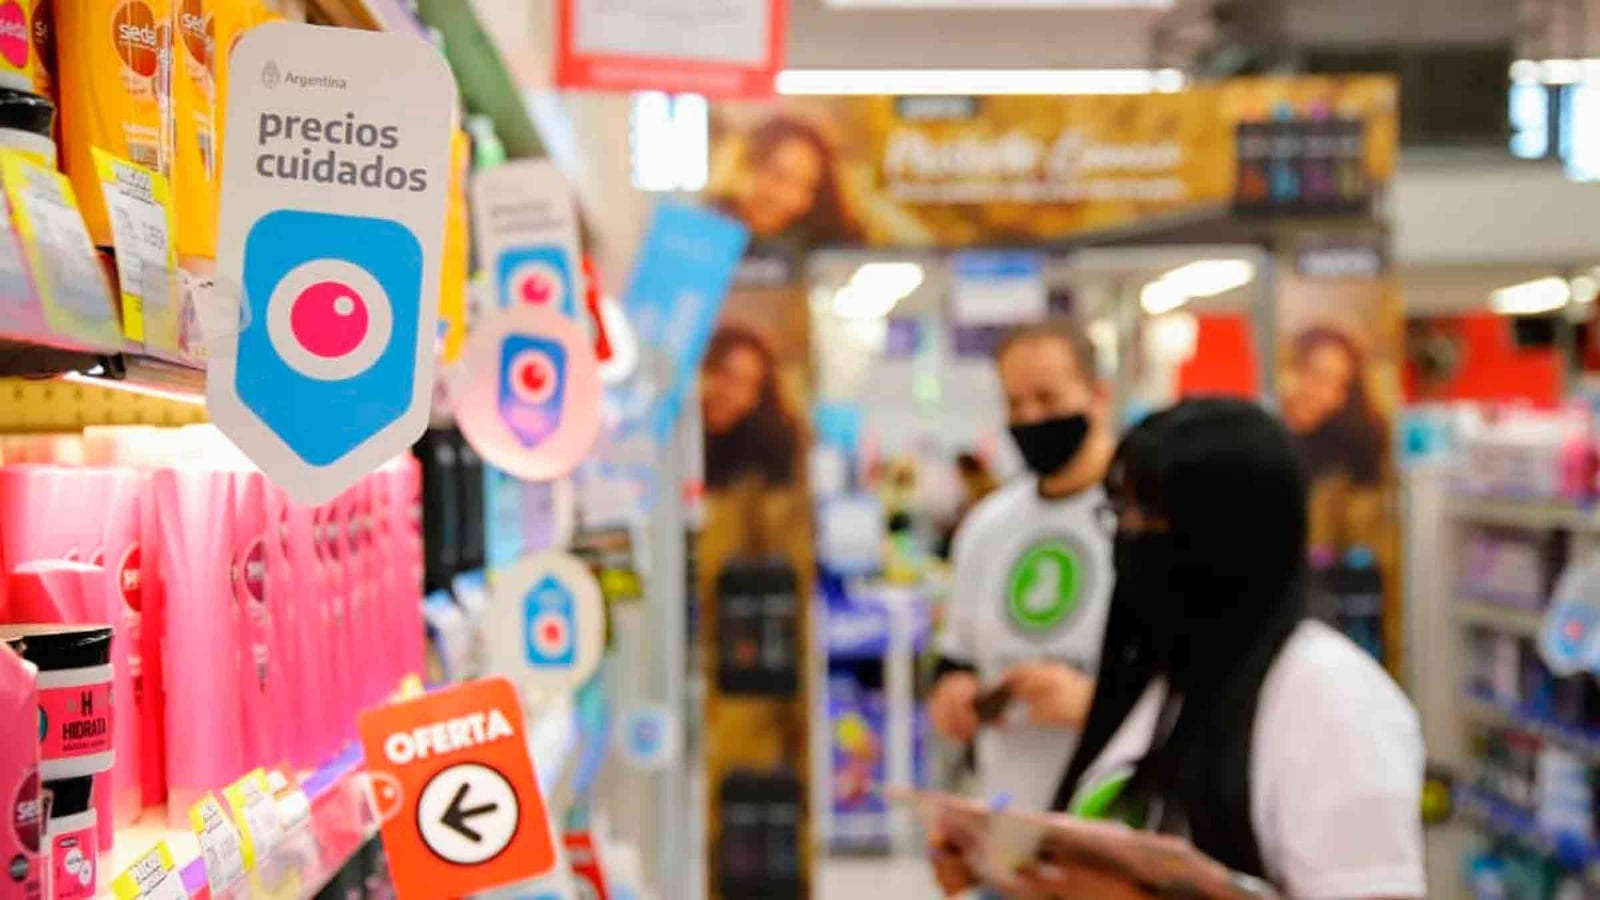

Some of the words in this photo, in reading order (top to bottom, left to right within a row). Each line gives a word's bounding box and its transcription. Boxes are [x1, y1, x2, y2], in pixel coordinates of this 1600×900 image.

[118, 23, 157, 45] seda
[285, 72, 347, 90] Argentina
[258, 111, 399, 149] precios
[256, 148, 428, 192] cuidados
[384, 708, 514, 765] OFERTA
